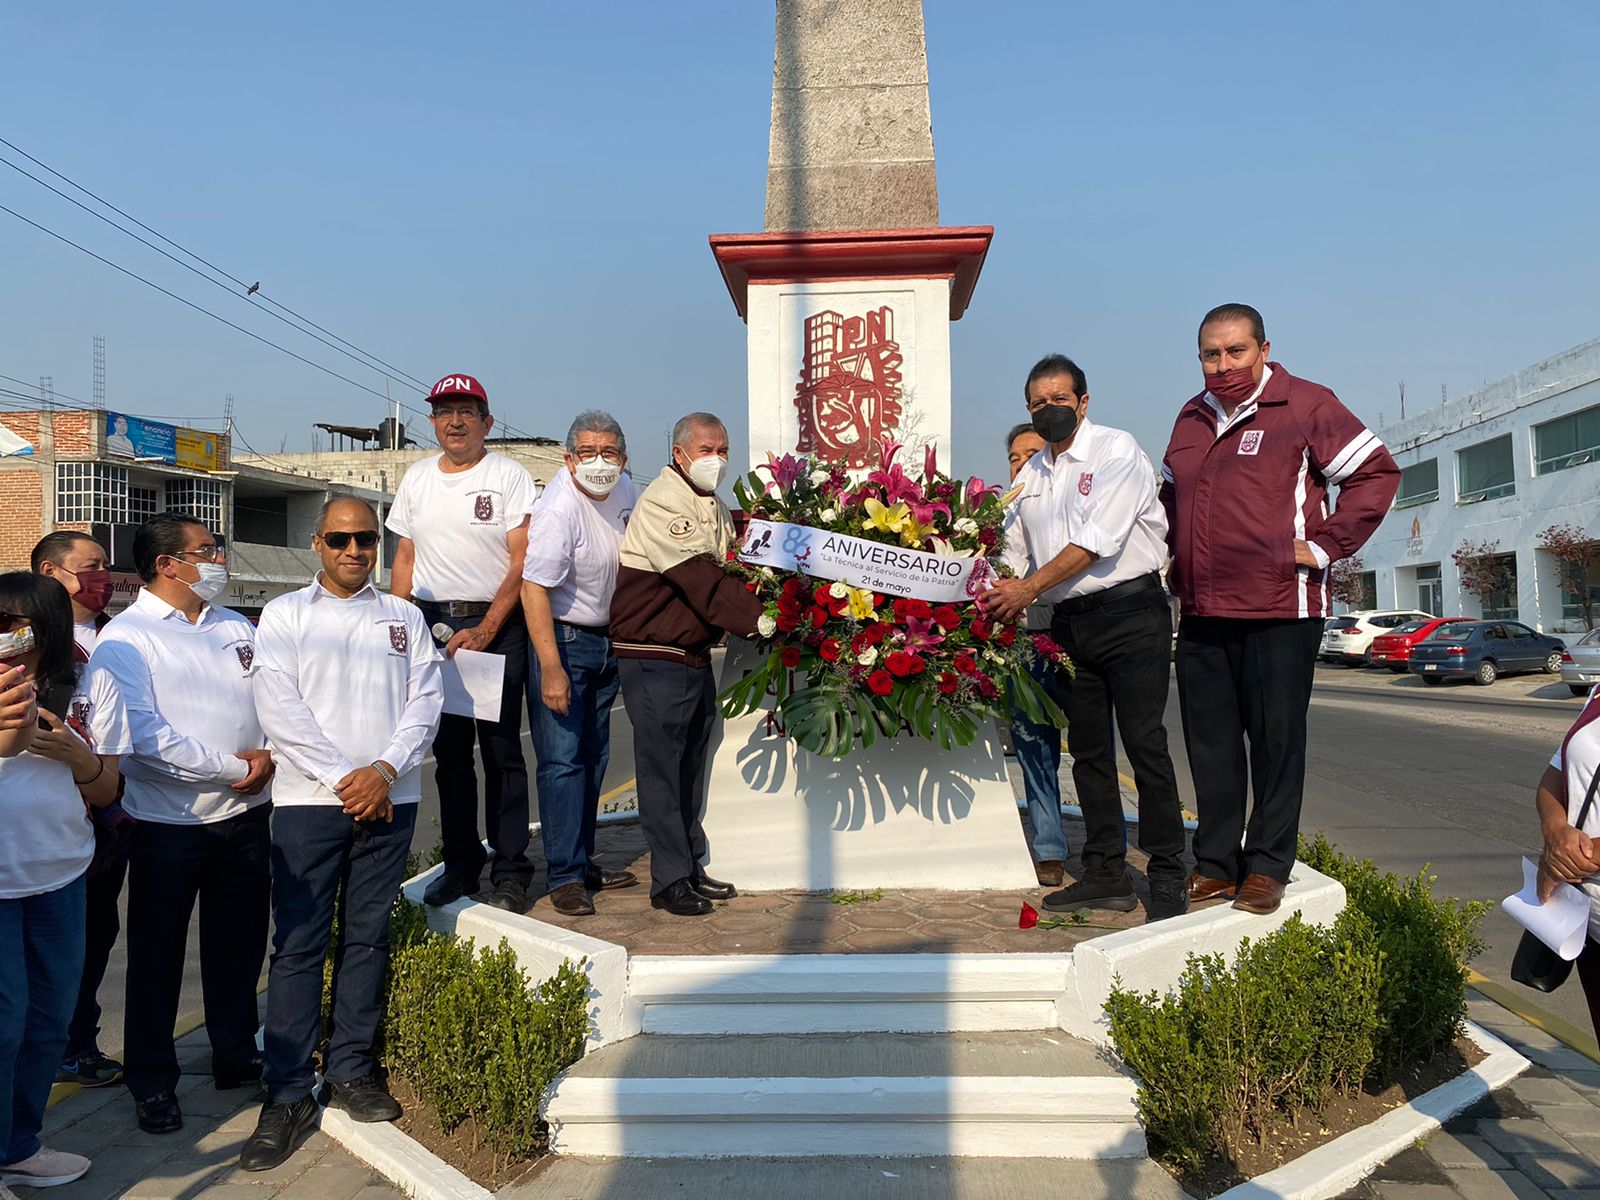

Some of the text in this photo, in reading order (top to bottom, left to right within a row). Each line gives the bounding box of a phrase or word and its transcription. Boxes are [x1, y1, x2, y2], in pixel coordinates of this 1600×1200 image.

[435, 377, 471, 395] IPN
[822, 536, 962, 577] ANIVERSARIO
[874, 566, 908, 579] Servicio
[908, 574, 920, 582] de
[921, 575, 930, 583] la
[861, 575, 912, 594] 21 de mayo
